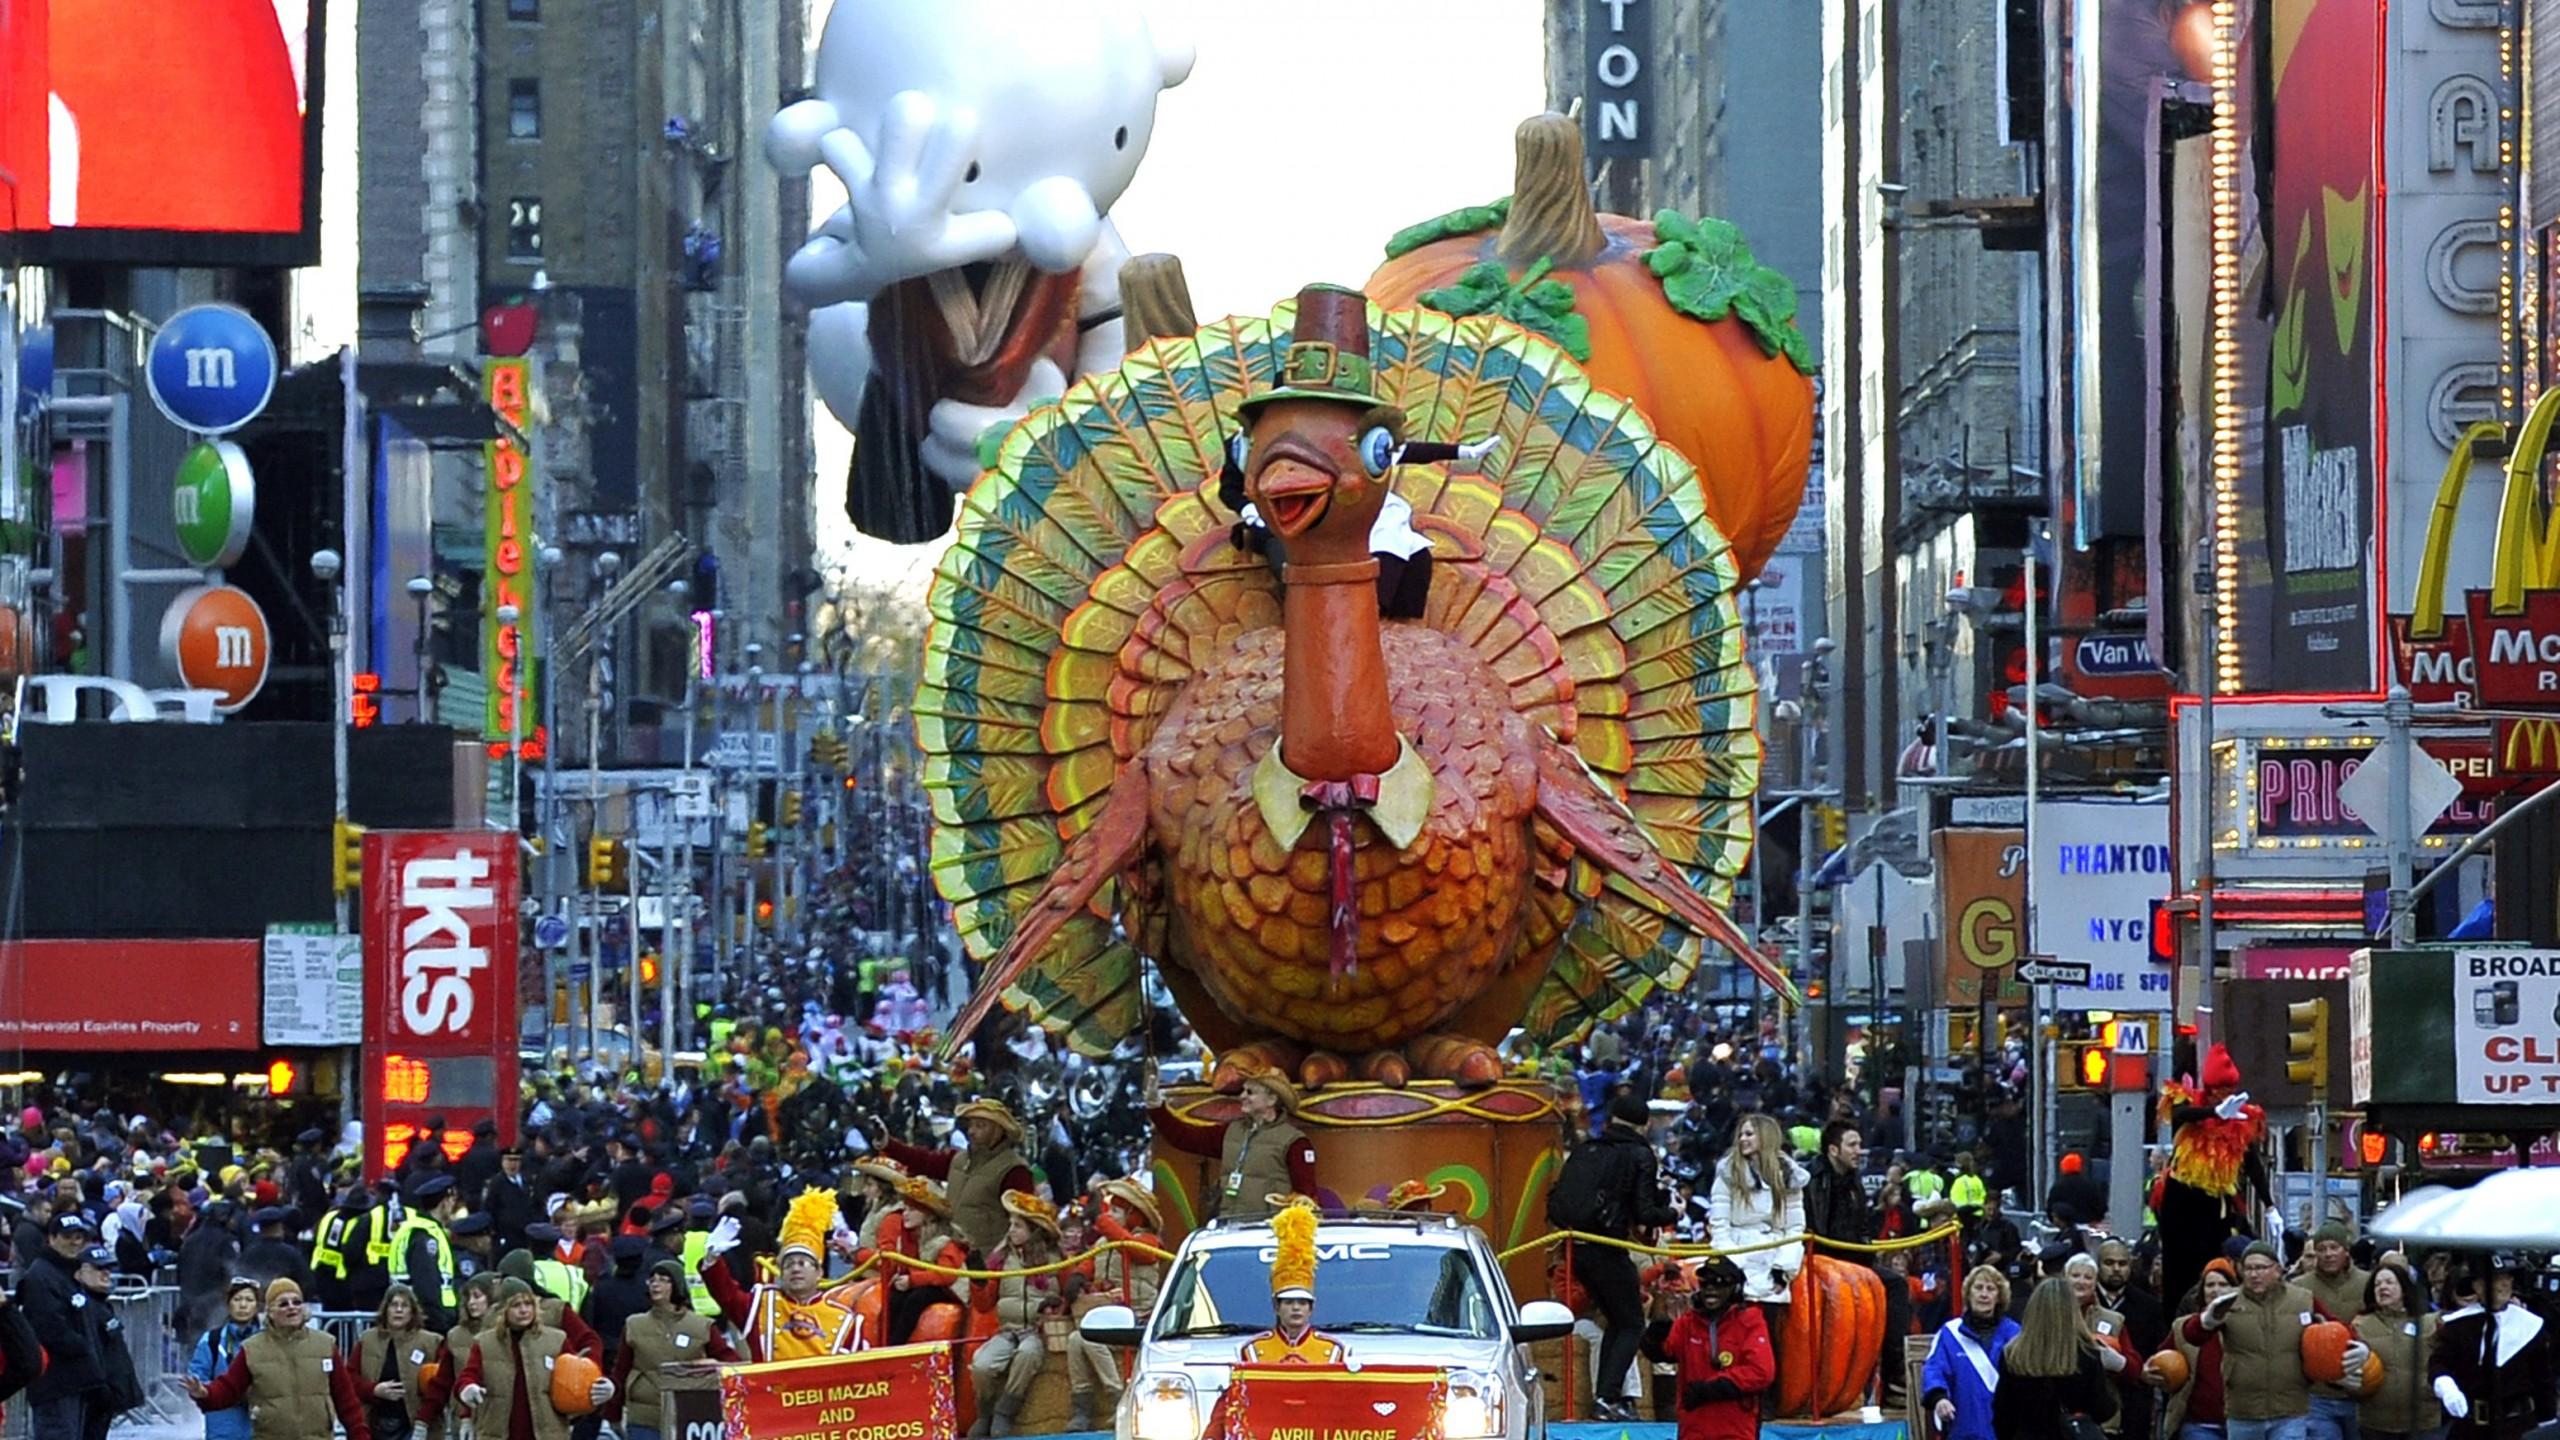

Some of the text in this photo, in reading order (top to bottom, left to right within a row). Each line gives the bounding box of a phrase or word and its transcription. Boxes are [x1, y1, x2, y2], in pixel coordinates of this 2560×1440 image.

[186, 347, 237, 389] m
[216, 626, 253, 668] m
[2081, 640, 2128, 664] Van
[2432, 757, 2493, 778] PE
[402, 847, 494, 1036] tkts
[2090, 917, 2144, 942] NYC
[84, 1021, 137, 1034] Equities
[141, 1021, 200, 1034] Property
[2484, 1036, 2560, 1064] CL
[2484, 1075, 2531, 1094] UP
[781, 1381, 889, 1407] DEBI MAZAR
[819, 1407, 855, 1425] AND
[846, 1421, 924, 1440] CORCOS
